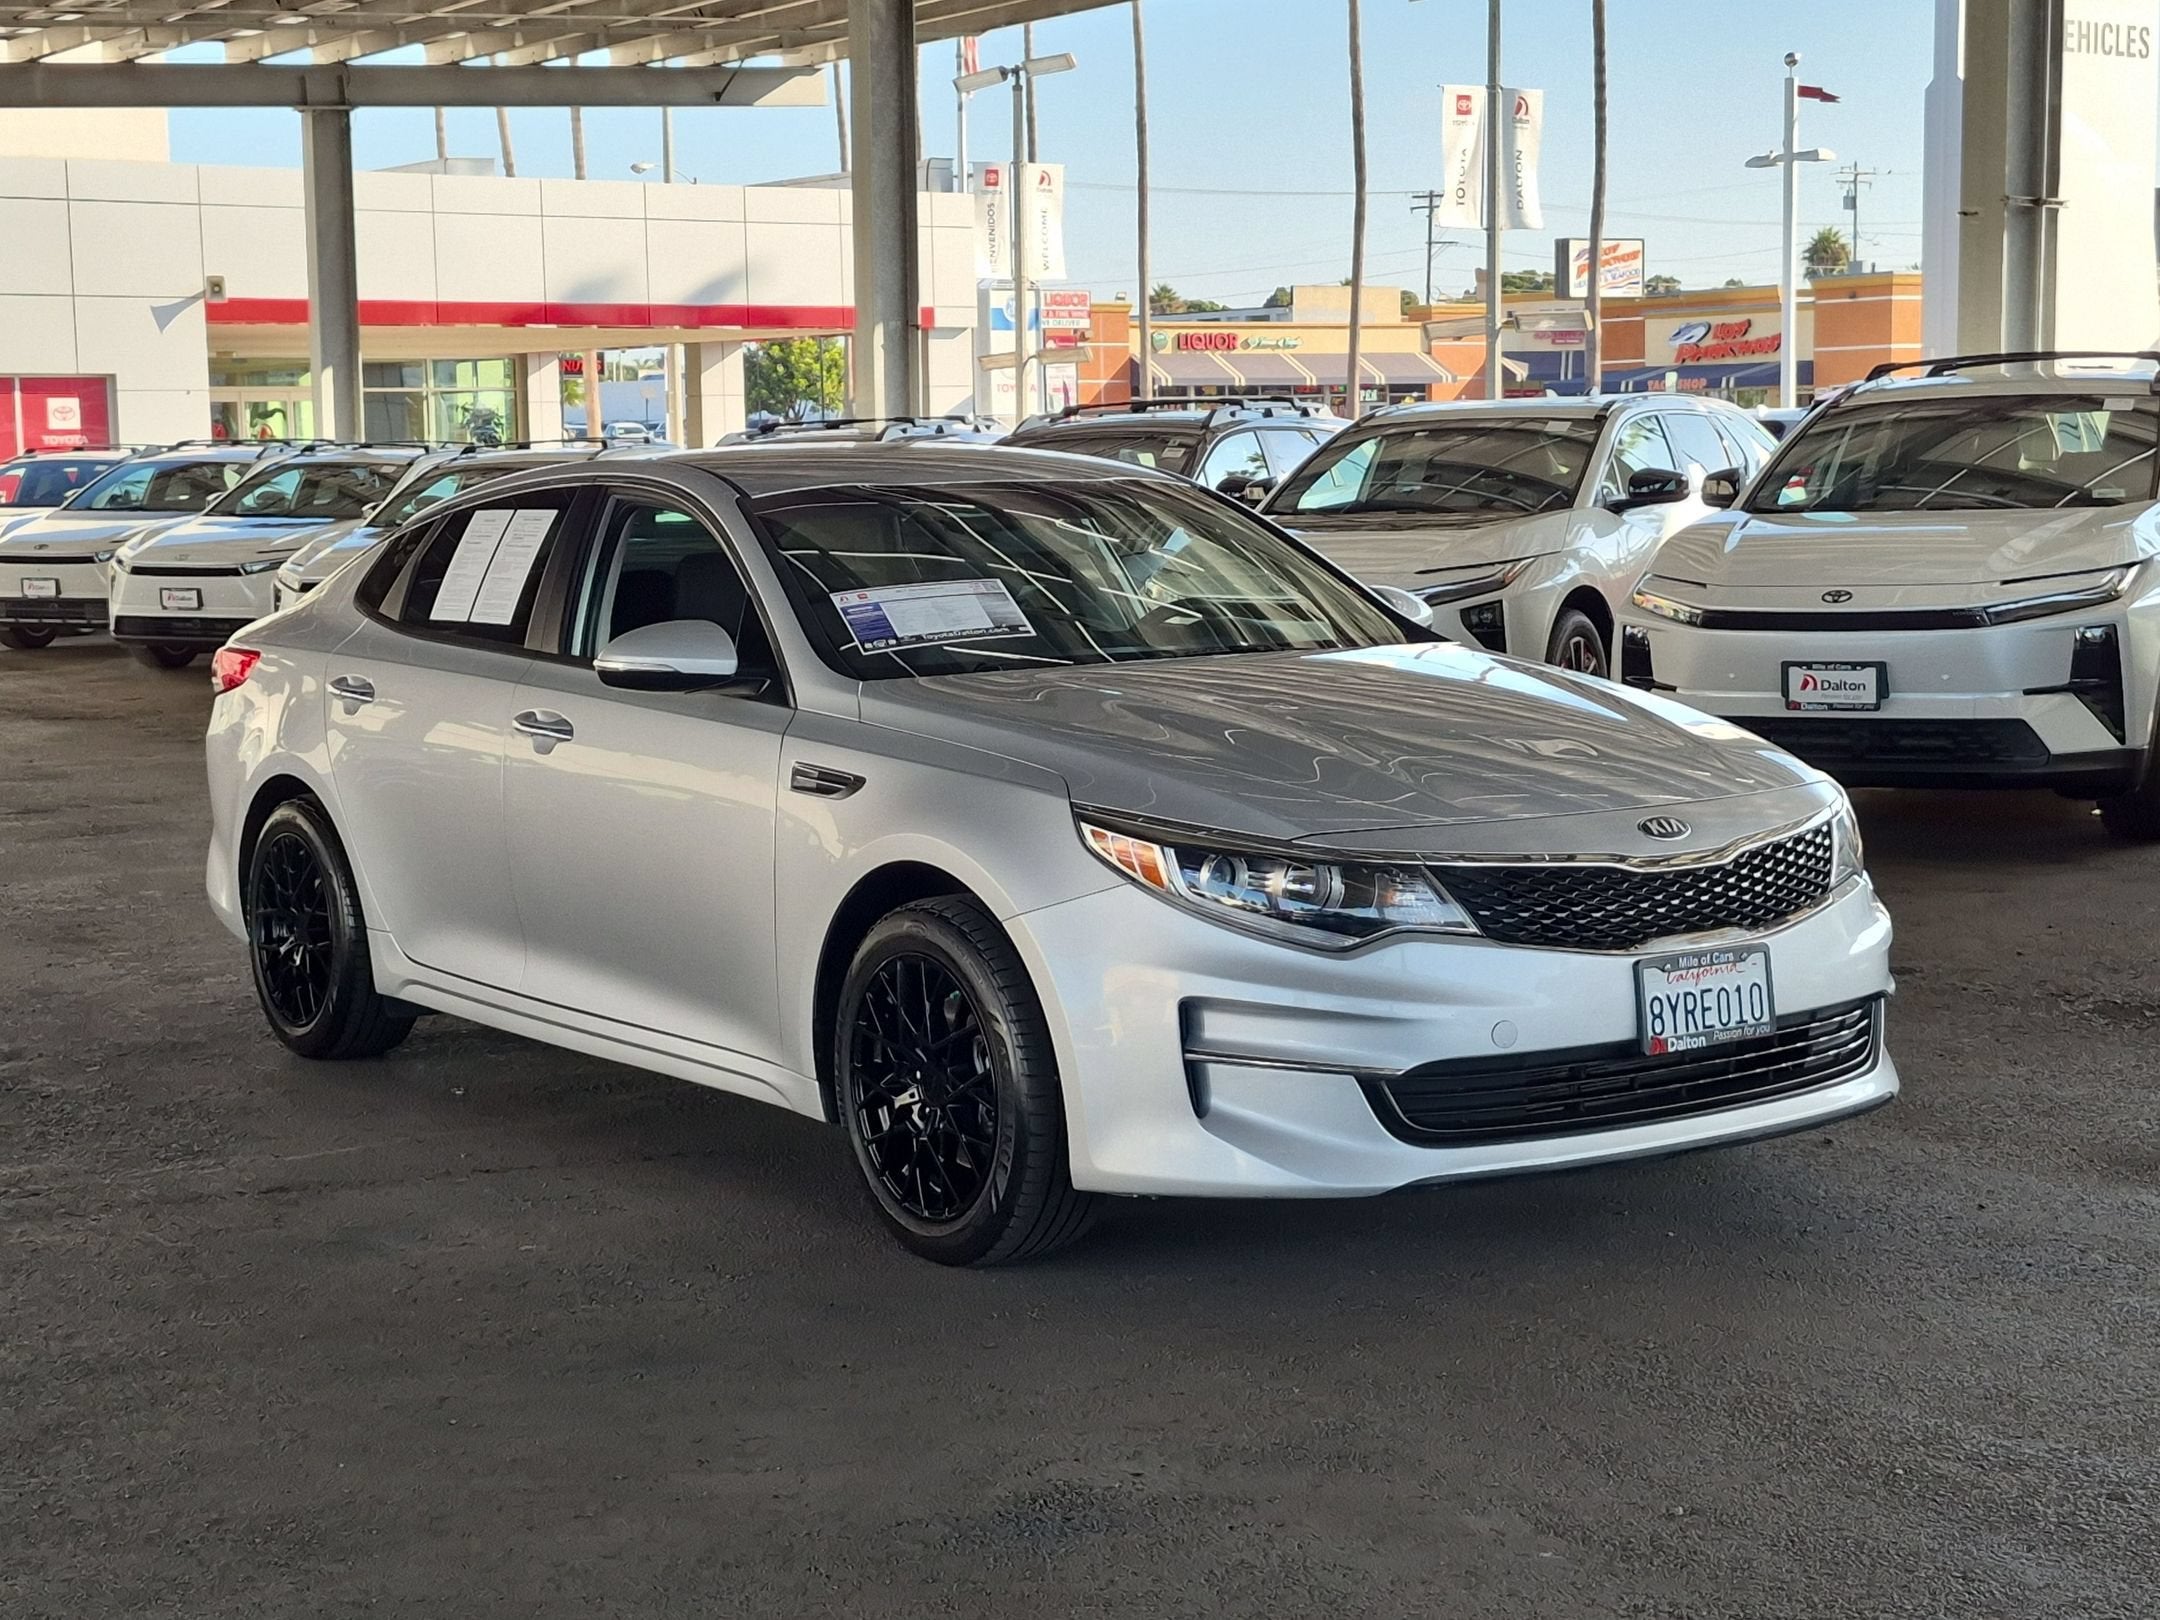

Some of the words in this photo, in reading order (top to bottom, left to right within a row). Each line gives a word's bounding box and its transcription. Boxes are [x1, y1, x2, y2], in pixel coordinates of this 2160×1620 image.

[2063, 19, 2150, 59] EHICLES
[1455, 147, 1467, 206] TOYOTA
[1514, 150, 1524, 210] DALTON
[1040, 207, 1050, 271] WELCOME
[1177, 332, 1238, 351] LIQUOR
[997, 383, 1037, 393] TOYA
[1647, 379, 1667, 391] TAC
[1678, 378, 1707, 390] SHOP
[1359, 389, 1378, 402] PEN
[41, 434, 88, 446] TOYOTA
[1821, 679, 1866, 692] Dalton
[1645, 818, 1687, 835] KIA
[1678, 955, 1699, 969] Mile
[1701, 953, 1711, 966] of
[1712, 952, 1734, 964] Cars
[1650, 982, 1764, 1036] 8YRE010
[1667, 1036, 1706, 1052] Dalton
[1713, 1027, 1742, 1041] Passion
[1743, 1024, 1754, 1037] for
[1756, 1024, 1770, 1038] you
